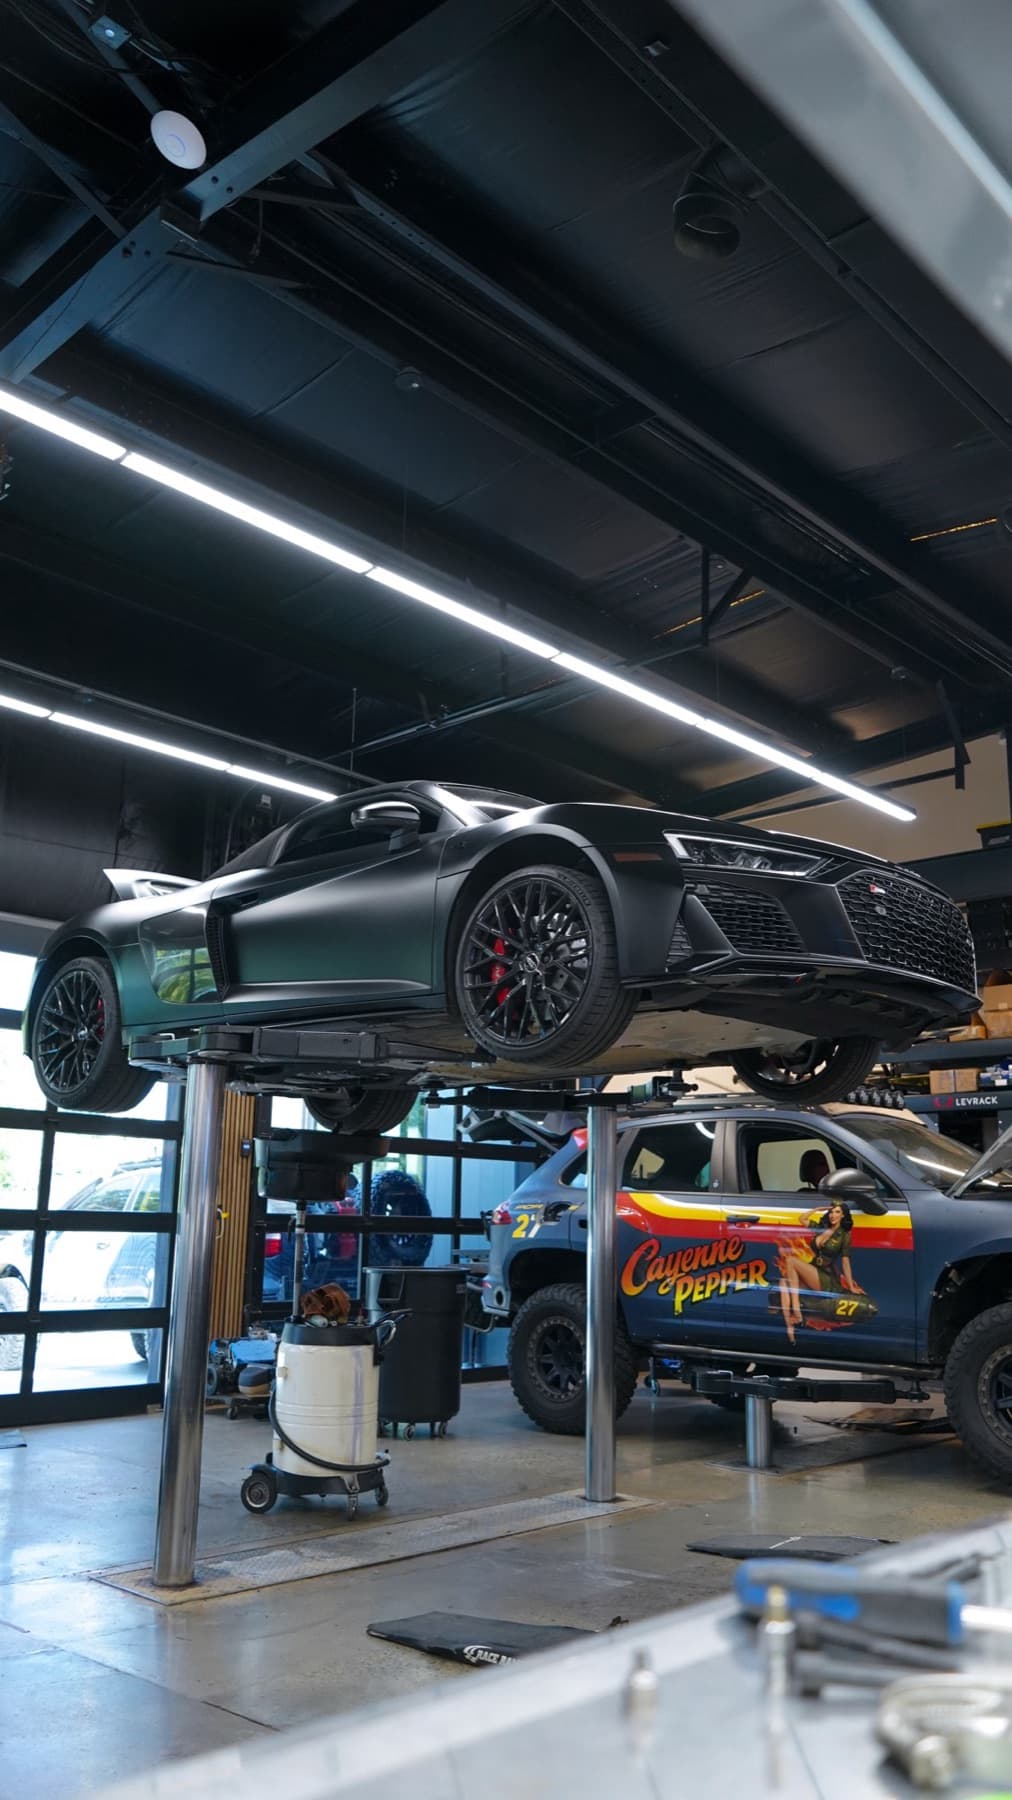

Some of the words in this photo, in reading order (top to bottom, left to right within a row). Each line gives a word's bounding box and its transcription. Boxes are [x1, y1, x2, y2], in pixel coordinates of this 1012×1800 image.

[955, 1096, 999, 1107] LEVRACK
[620, 1234, 745, 1297] Cayenne
[673, 1259, 770, 1316] PEPPER
[835, 1300, 859, 1317] 27
